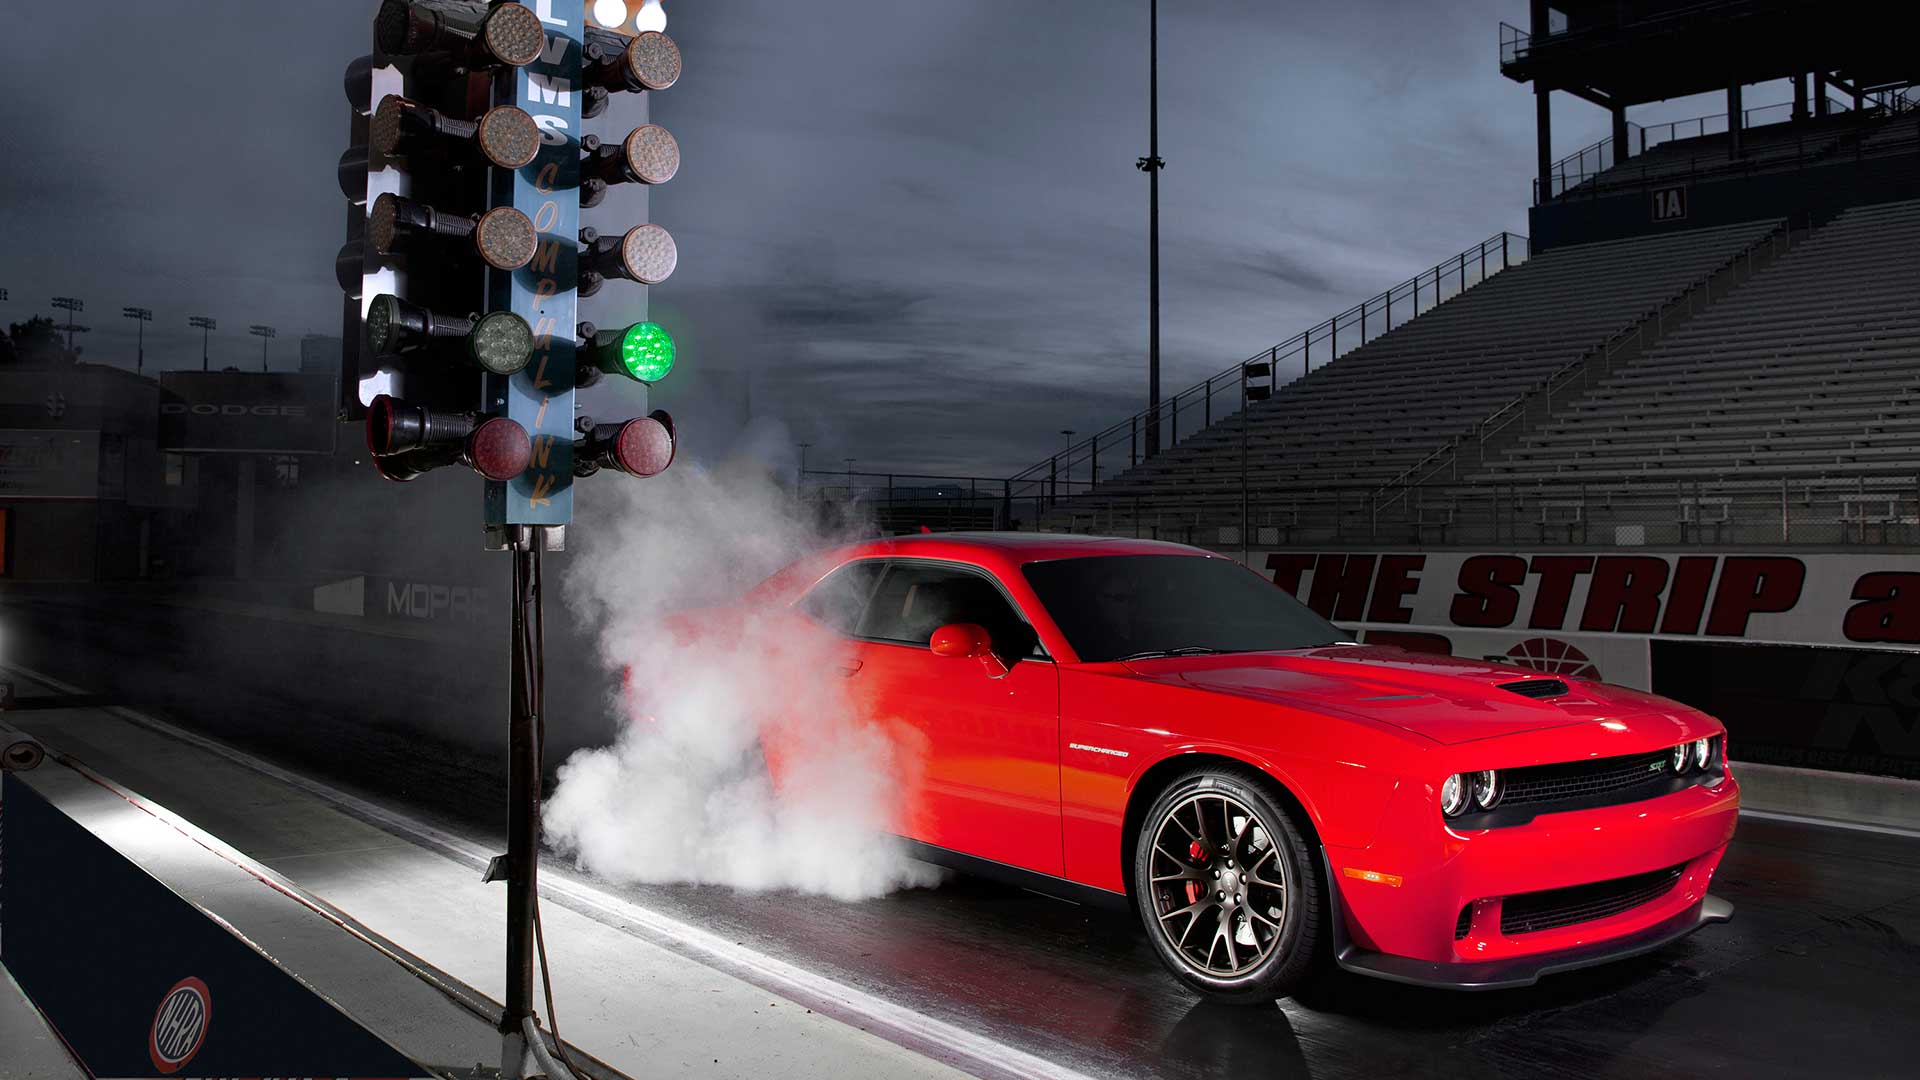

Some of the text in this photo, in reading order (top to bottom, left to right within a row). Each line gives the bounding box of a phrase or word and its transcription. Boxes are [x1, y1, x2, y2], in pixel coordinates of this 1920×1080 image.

[528, 0, 571, 146] LVMS
[1655, 188, 1682, 218] 1A
[530, 162, 560, 509] COMPULINK
[160, 403, 305, 416] DODGE
[1265, 554, 1427, 622] THE
[1450, 555, 1806, 637] STRIP
[157, 991, 203, 1057] NHRA
